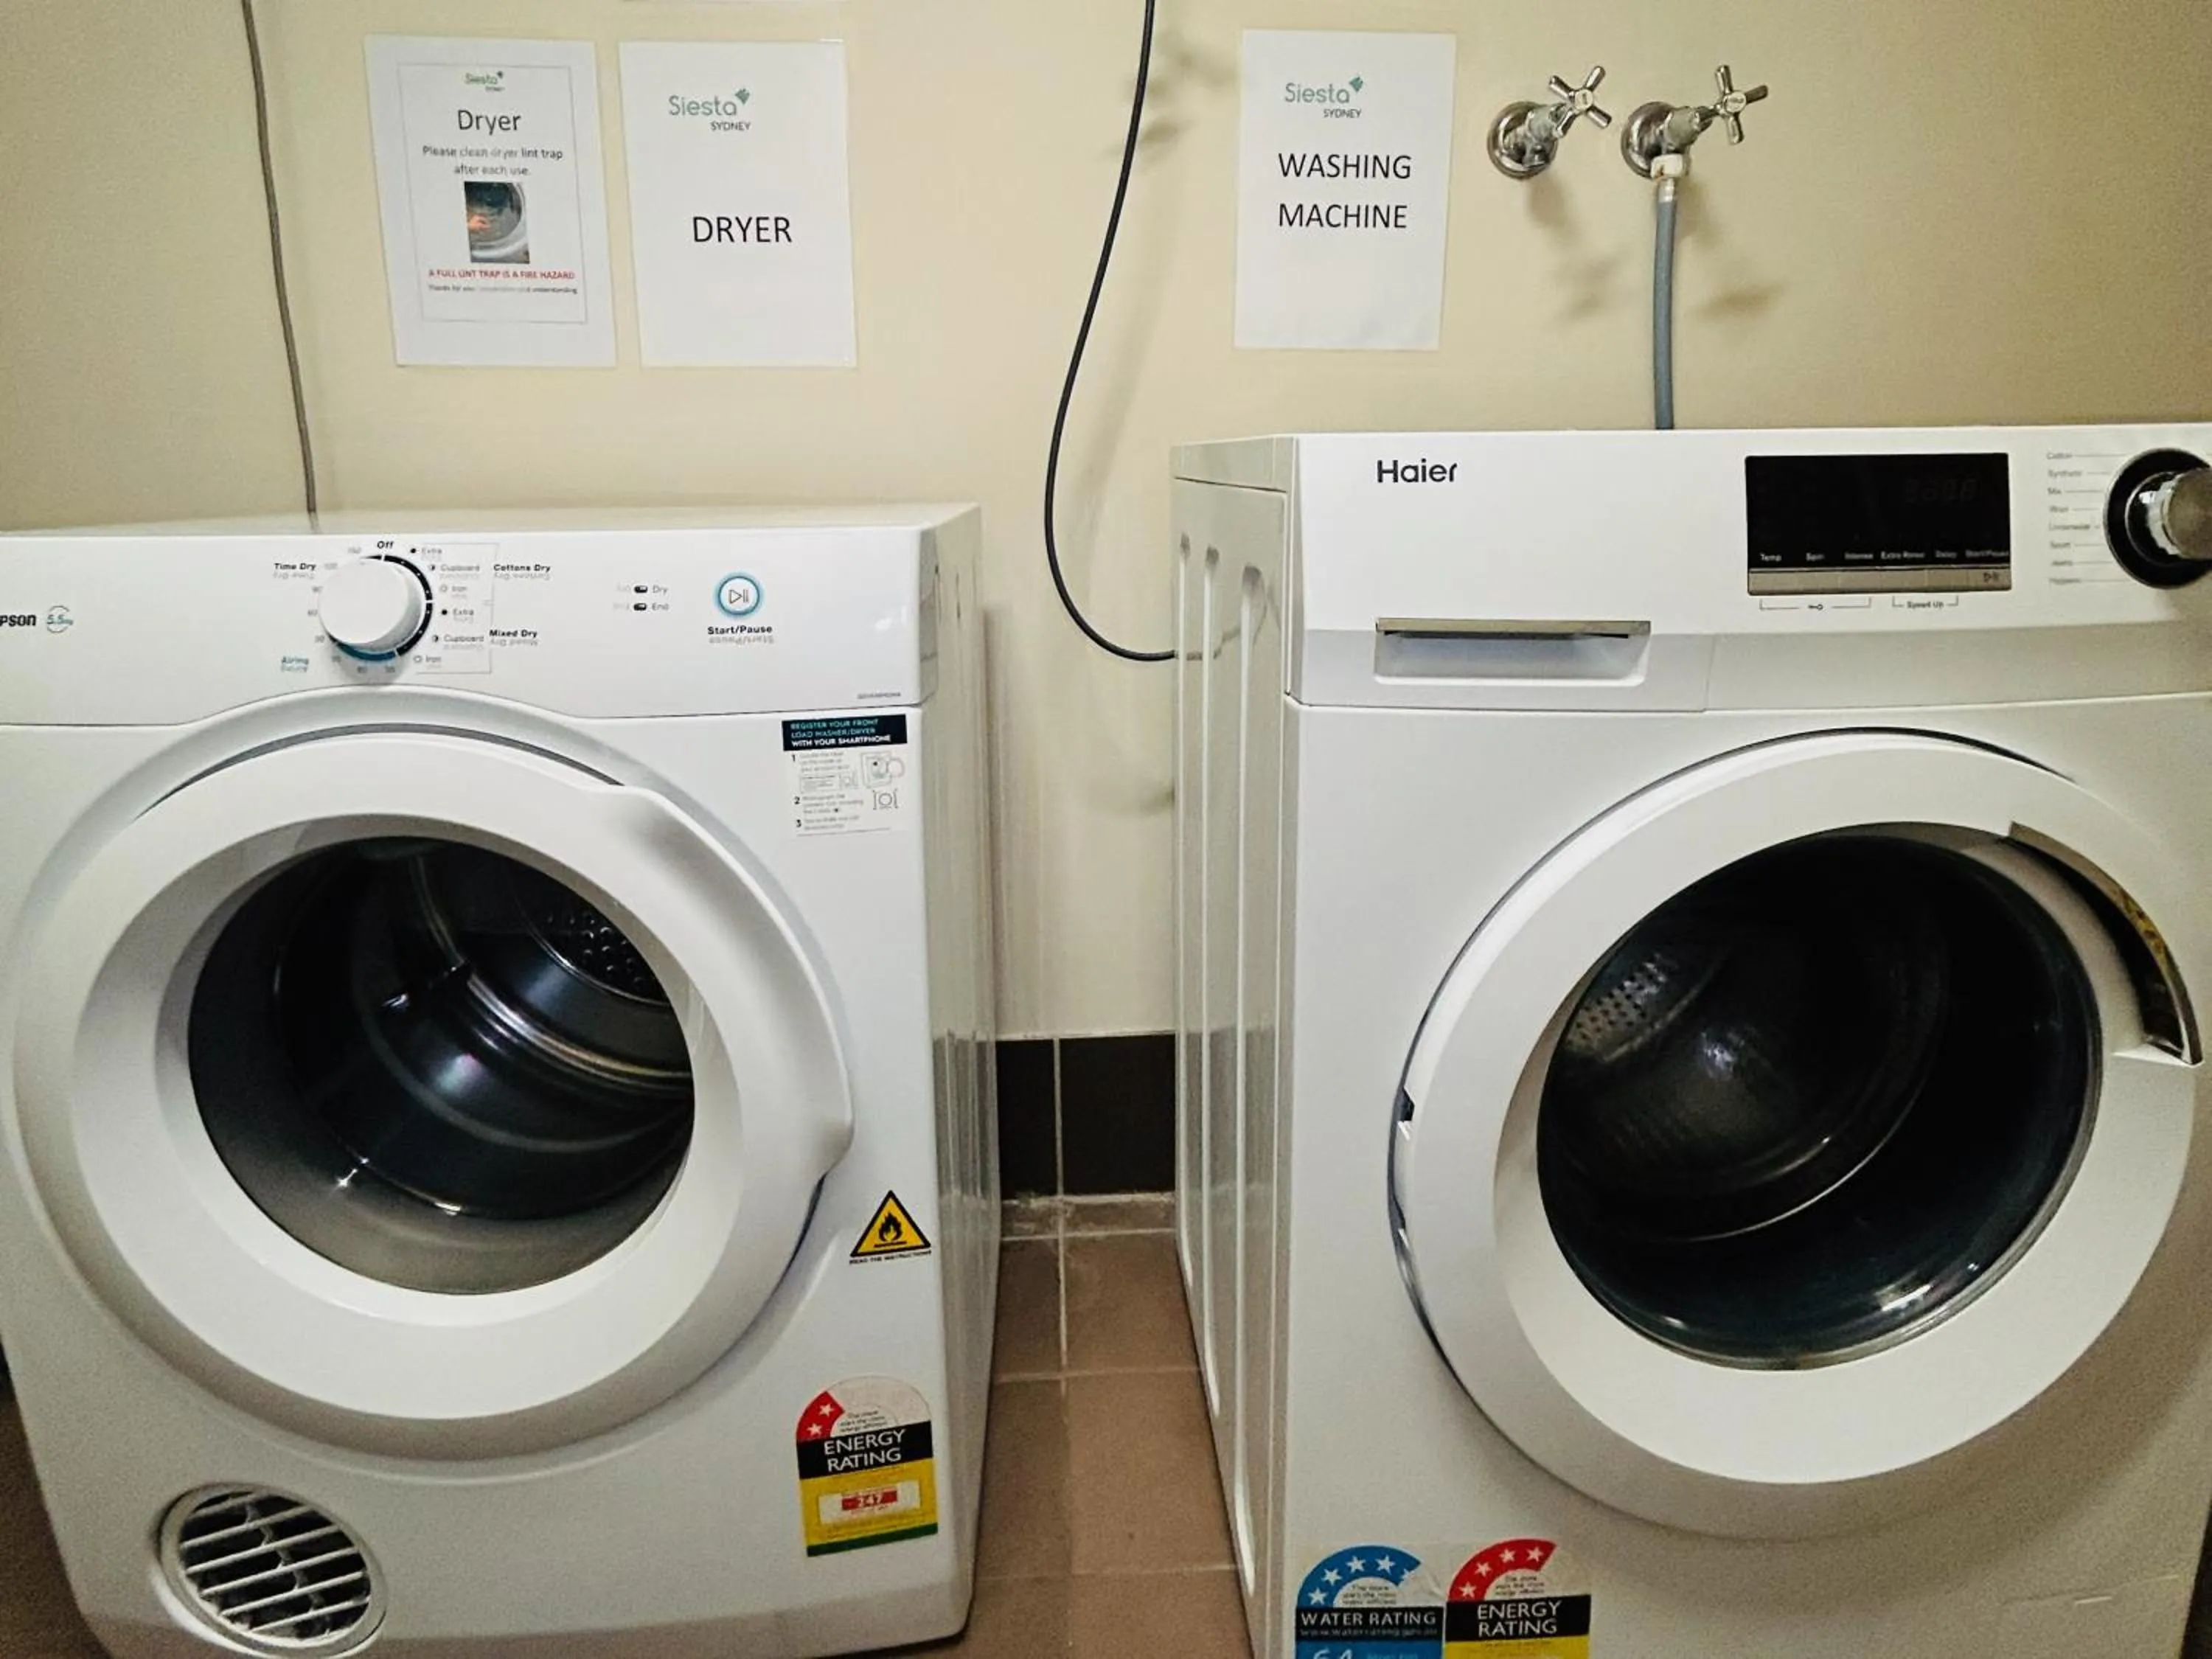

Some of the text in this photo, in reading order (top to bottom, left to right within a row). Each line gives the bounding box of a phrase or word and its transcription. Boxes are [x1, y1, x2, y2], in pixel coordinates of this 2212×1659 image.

[1284, 82, 1350, 103] Siesta
[669, 95, 737, 116] Siesta
[1324, 109, 1362, 118] SYDNEY
[458, 109, 521, 136] Dryer
[710, 121, 751, 131] SYDNEY
[422, 145, 456, 156] Please
[460, 147, 487, 158] clean
[521, 148, 537, 159] lint
[541, 149, 563, 161] trap
[454, 163, 478, 175] after
[482, 164, 507, 175] each
[1278, 152, 1412, 179] WASHING
[1279, 203, 1408, 229] MACHINE
[692, 216, 793, 243] DRYER
[437, 270, 456, 278] FULL
[479, 270, 500, 278] TRAP
[521, 271, 538, 279] FIRE
[540, 271, 575, 279] HAZARD
[1377, 458, 1458, 483] Haier
[377, 540, 394, 549] Off
[1759, 552, 1782, 562] Temp
[299, 563, 316, 571] Dry
[534, 564, 551, 572] Dry
[653, 585, 669, 595] Dry
[652, 602, 669, 611] End
[490, 629, 538, 638] Mixed Dry
[707, 625, 773, 635] Start/Pause
[790, 722, 827, 730] REGISTER
[838, 734, 891, 744] SMARTPHONE
[794, 796, 800, 804] 2
[796, 819, 801, 827] 3
[824, 1429, 905, 1455] ENERGY
[827, 1447, 902, 1472] RATING
[1478, 1599, 1562, 1620] ENERGY
[1301, 1611, 1436, 1626] WATER RATING
[1478, 1617, 1557, 1638] RATING
